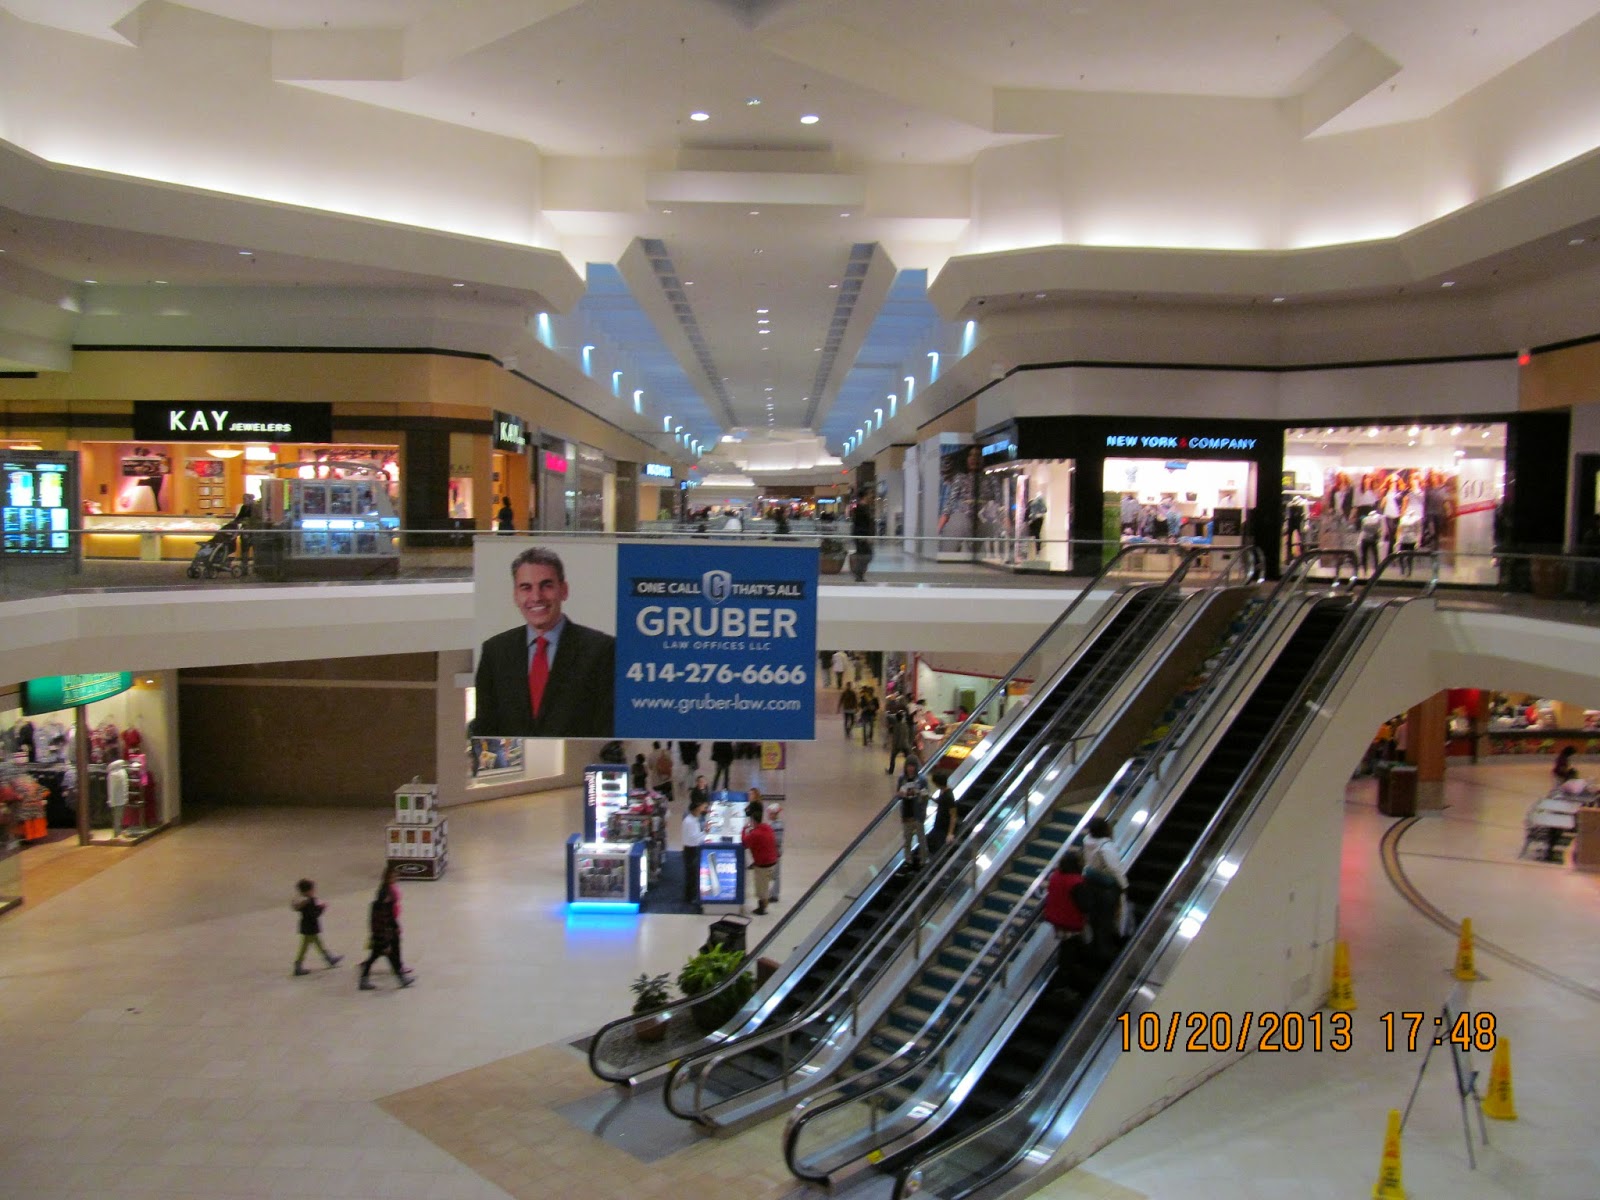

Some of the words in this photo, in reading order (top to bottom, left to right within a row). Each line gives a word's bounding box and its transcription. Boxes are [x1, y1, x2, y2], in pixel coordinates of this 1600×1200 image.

[169, 410, 229, 431] KAY
[229, 422, 292, 432] JEWELERS
[1106, 435, 1139, 447] NEW
[1140, 436, 1178, 448] YORK
[1188, 437, 1258, 450] COMPANY
[637, 582, 666, 594] ONE
[668, 582, 701, 594] CALL
[732, 583, 776, 595] THAT'S
[776, 584, 801, 596] ALL
[635, 605, 798, 638] GRUBER
[662, 640, 690, 650] LAW
[693, 641, 745, 650] OFFICES
[749, 642, 772, 651] LLC
[626, 662, 807, 684] 414-276-6666
[631, 692, 802, 714] www.gruber-law.com
